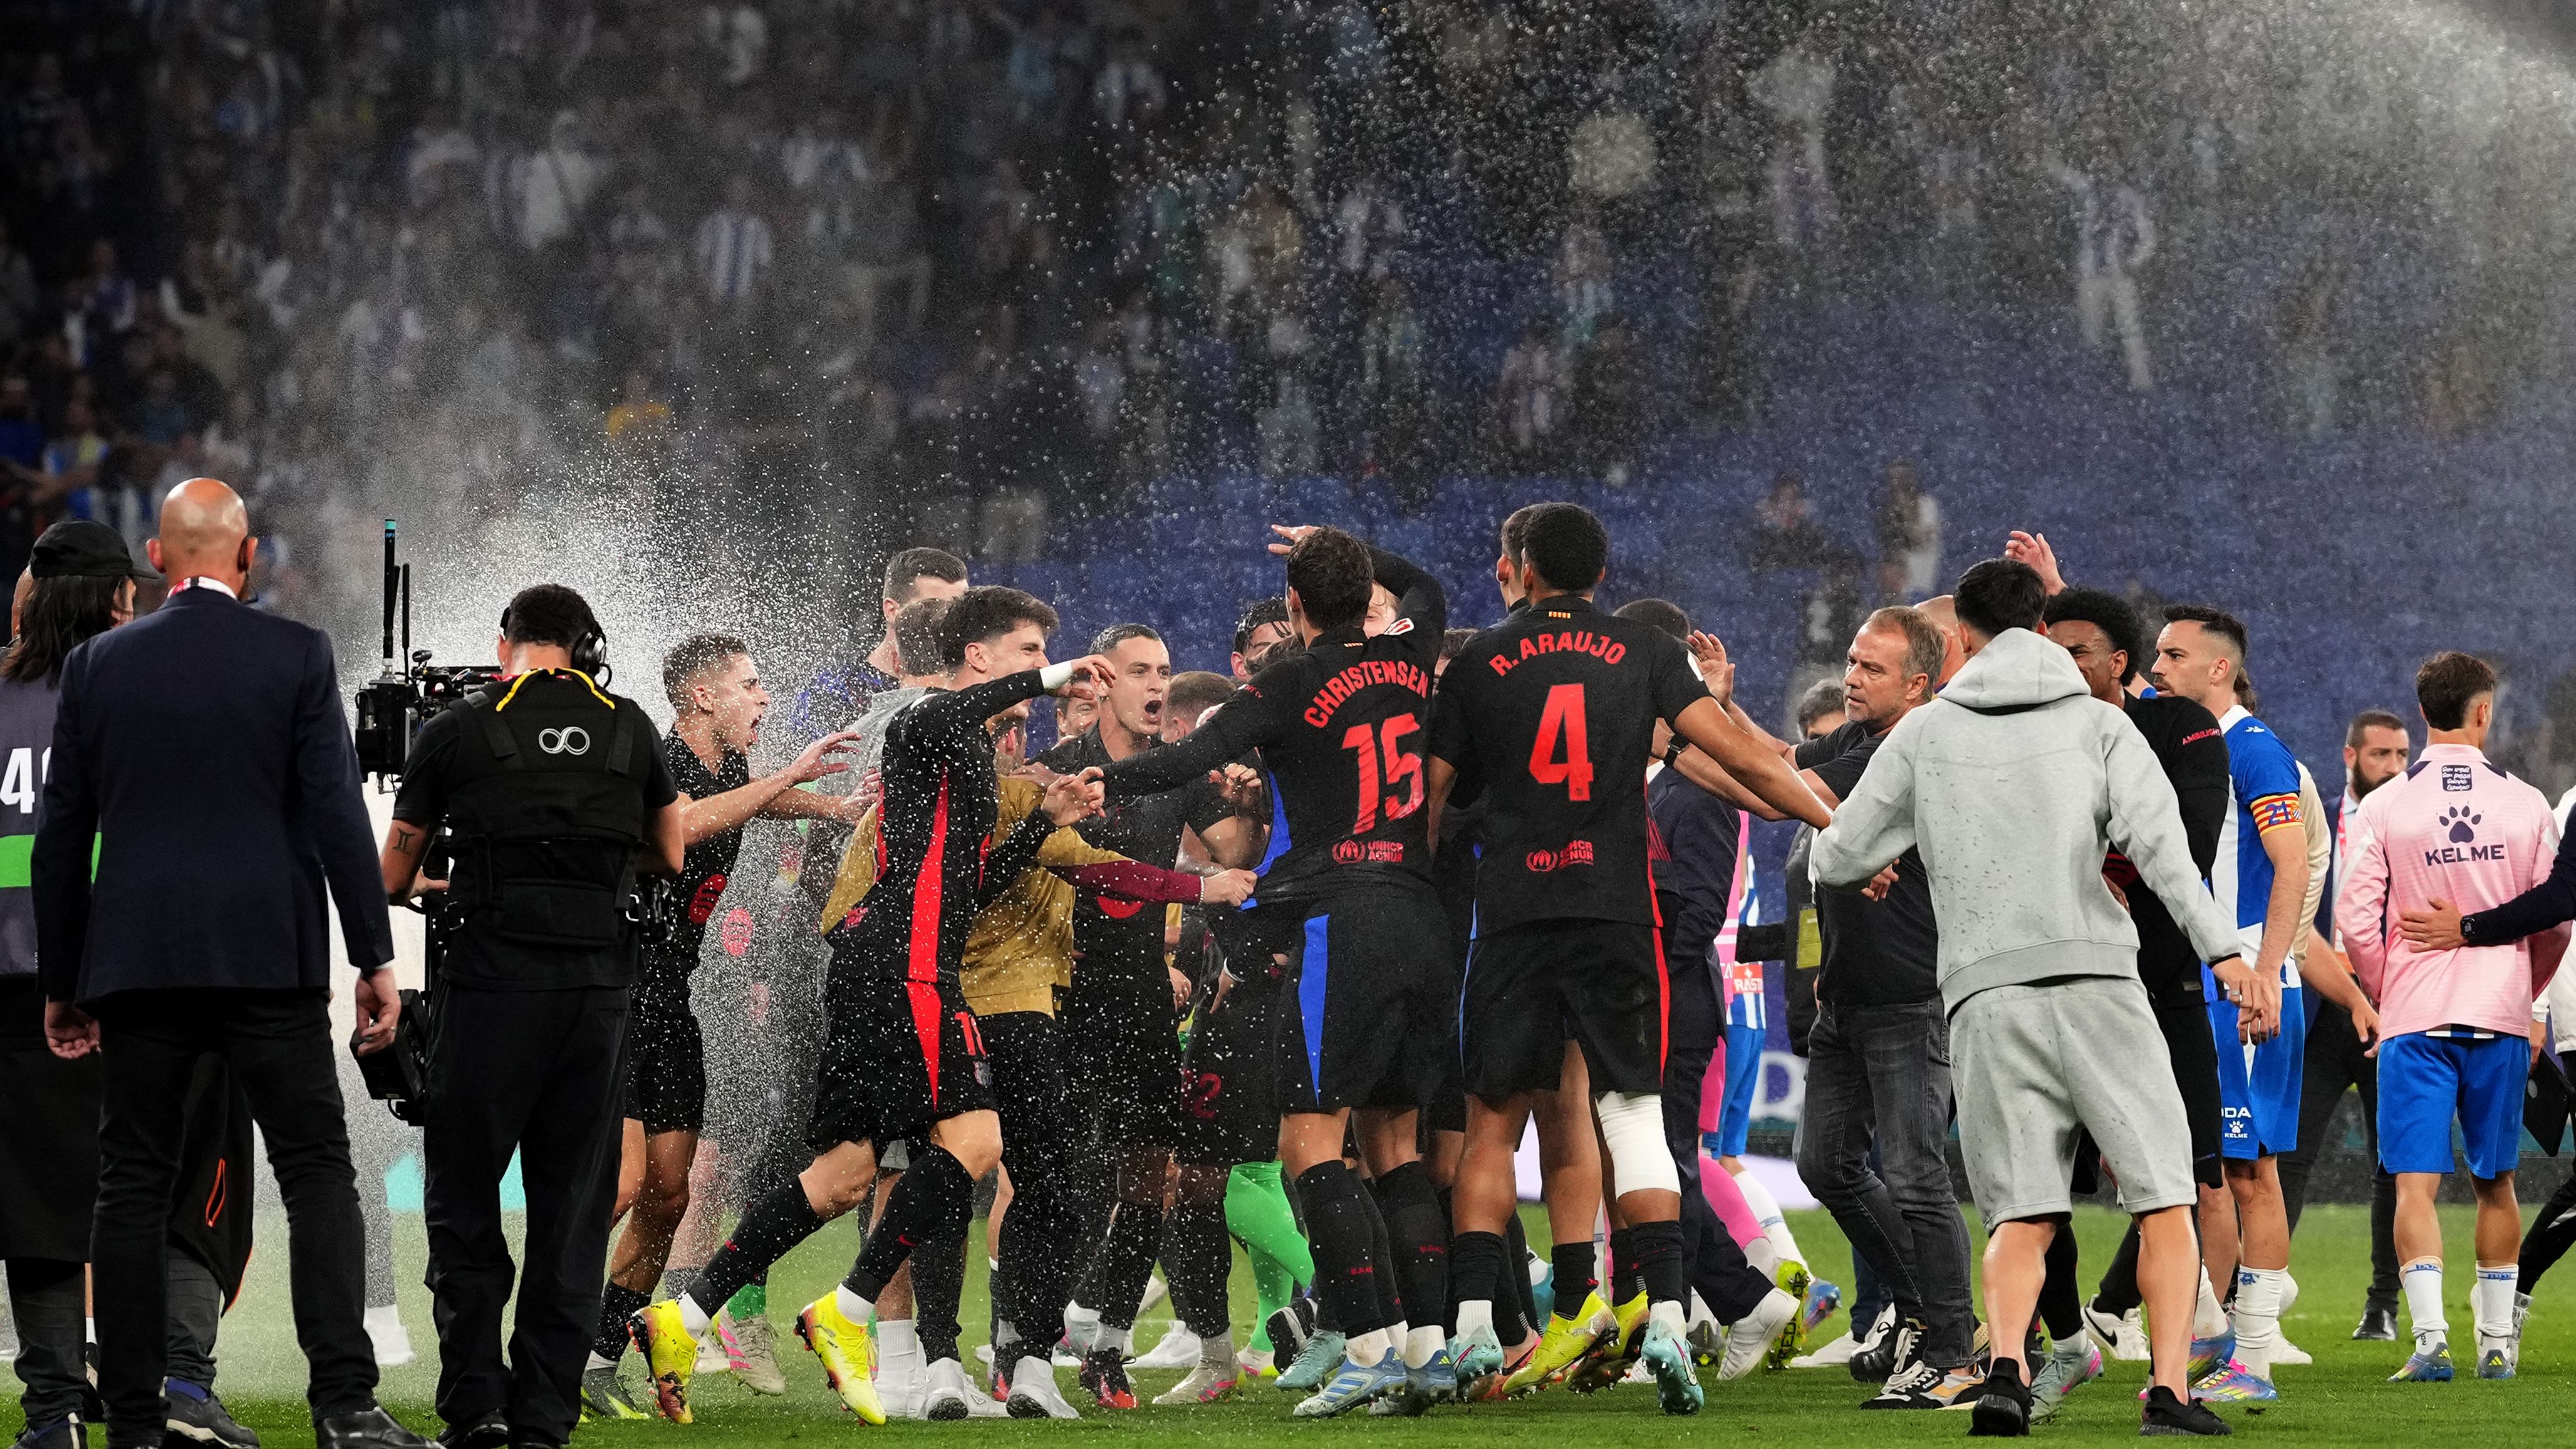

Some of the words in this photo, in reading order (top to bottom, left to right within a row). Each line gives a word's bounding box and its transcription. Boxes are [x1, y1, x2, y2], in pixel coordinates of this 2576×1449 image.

[1489, 654, 1519, 677] R.
[1520, 631, 1626, 665] ARAUJO
[1304, 660, 1428, 728] CHRISTENSEN
[1529, 683, 1593, 801] 4
[0, 746, 51, 814] 4
[1342, 712, 1424, 834] 15
[2425, 844, 2505, 866] KELME
[954, 1011, 987, 1057] 1
[2221, 1107, 2251, 1118] DA
